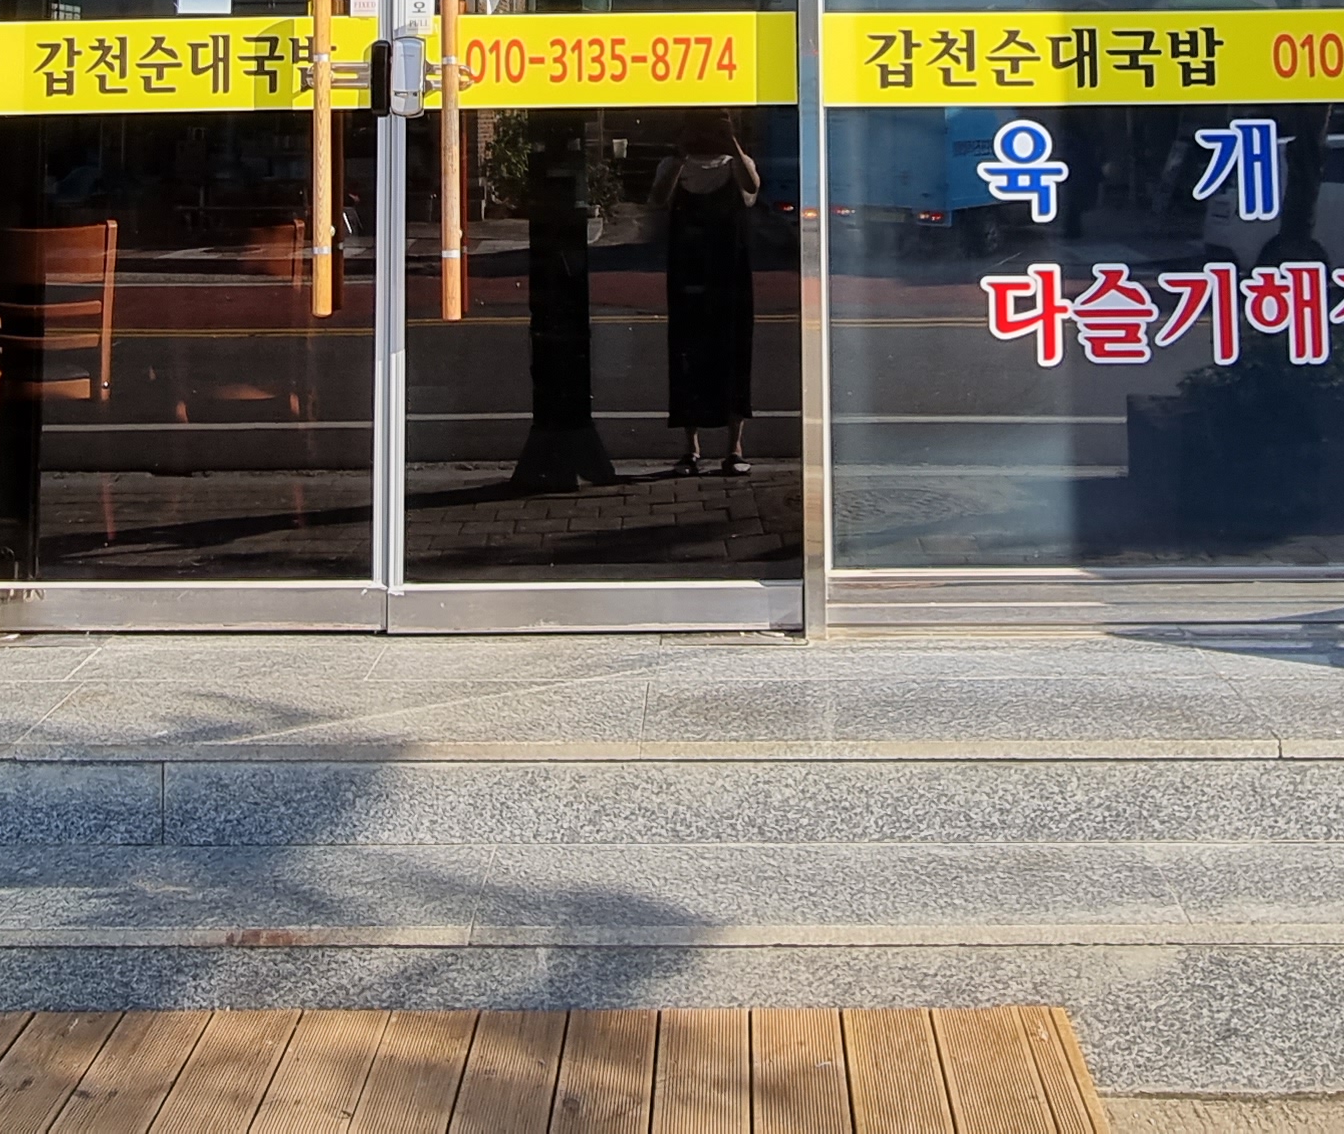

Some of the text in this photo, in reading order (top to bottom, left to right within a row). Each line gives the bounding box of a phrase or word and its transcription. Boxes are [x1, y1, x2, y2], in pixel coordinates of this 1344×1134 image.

[354, 1, 376, 9] FIXED
[466, 36, 737, 84] 010-3135-8774
[865, 27, 1225, 89] 갑천순대국밥
